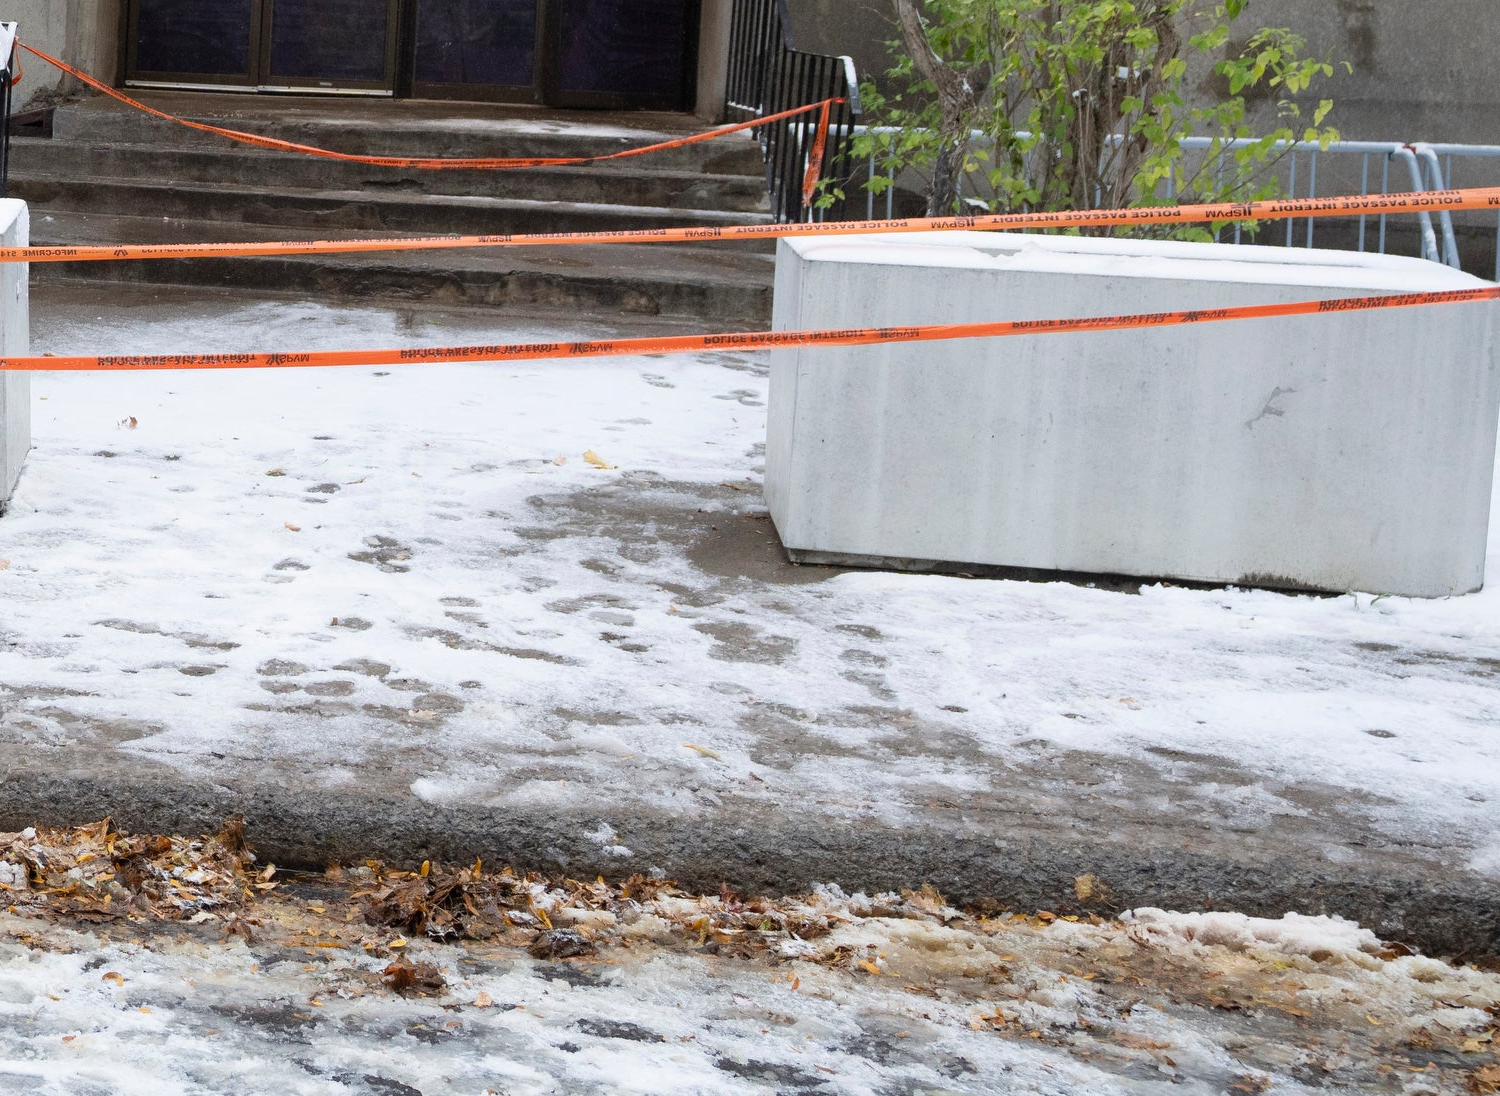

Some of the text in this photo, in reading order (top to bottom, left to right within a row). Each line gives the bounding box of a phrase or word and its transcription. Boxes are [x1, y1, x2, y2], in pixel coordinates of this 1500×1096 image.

[1269, 196, 1463, 212] POLICE PASSAGE INTERDIT
[992, 210, 1181, 224] POLICE PASSAGE INTERDIT
[1205, 209, 1242, 218] SPVM
[797, 223, 855, 232] PASSAGE
[860, 220, 909, 229] POLICE
[931, 220, 966, 229] SPVM
[685, 229, 713, 238] SPVM
[1395, 298, 1416, 307] 514
